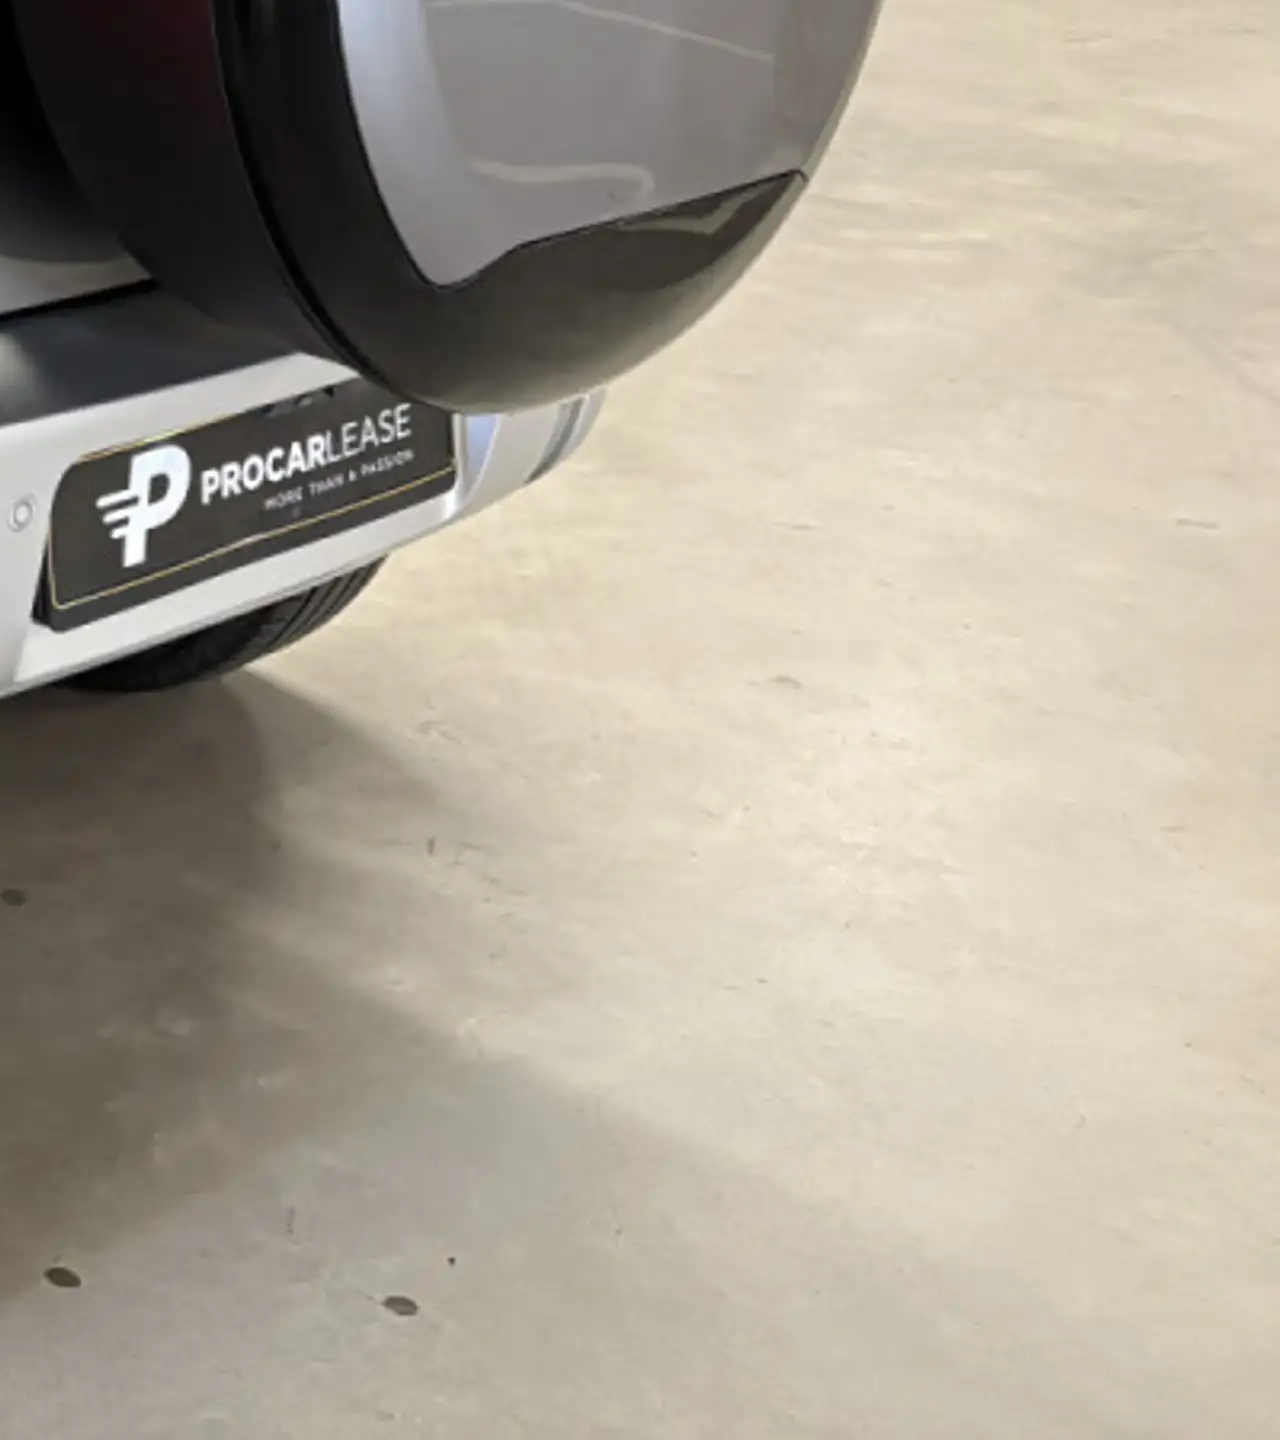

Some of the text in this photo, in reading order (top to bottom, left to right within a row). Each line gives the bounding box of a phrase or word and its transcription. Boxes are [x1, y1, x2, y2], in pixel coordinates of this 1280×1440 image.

[200, 402, 413, 506] PROCARLEASE
[264, 485, 304, 511] MORE
[308, 473, 345, 497] THAN
[360, 448, 415, 478] PASSION
